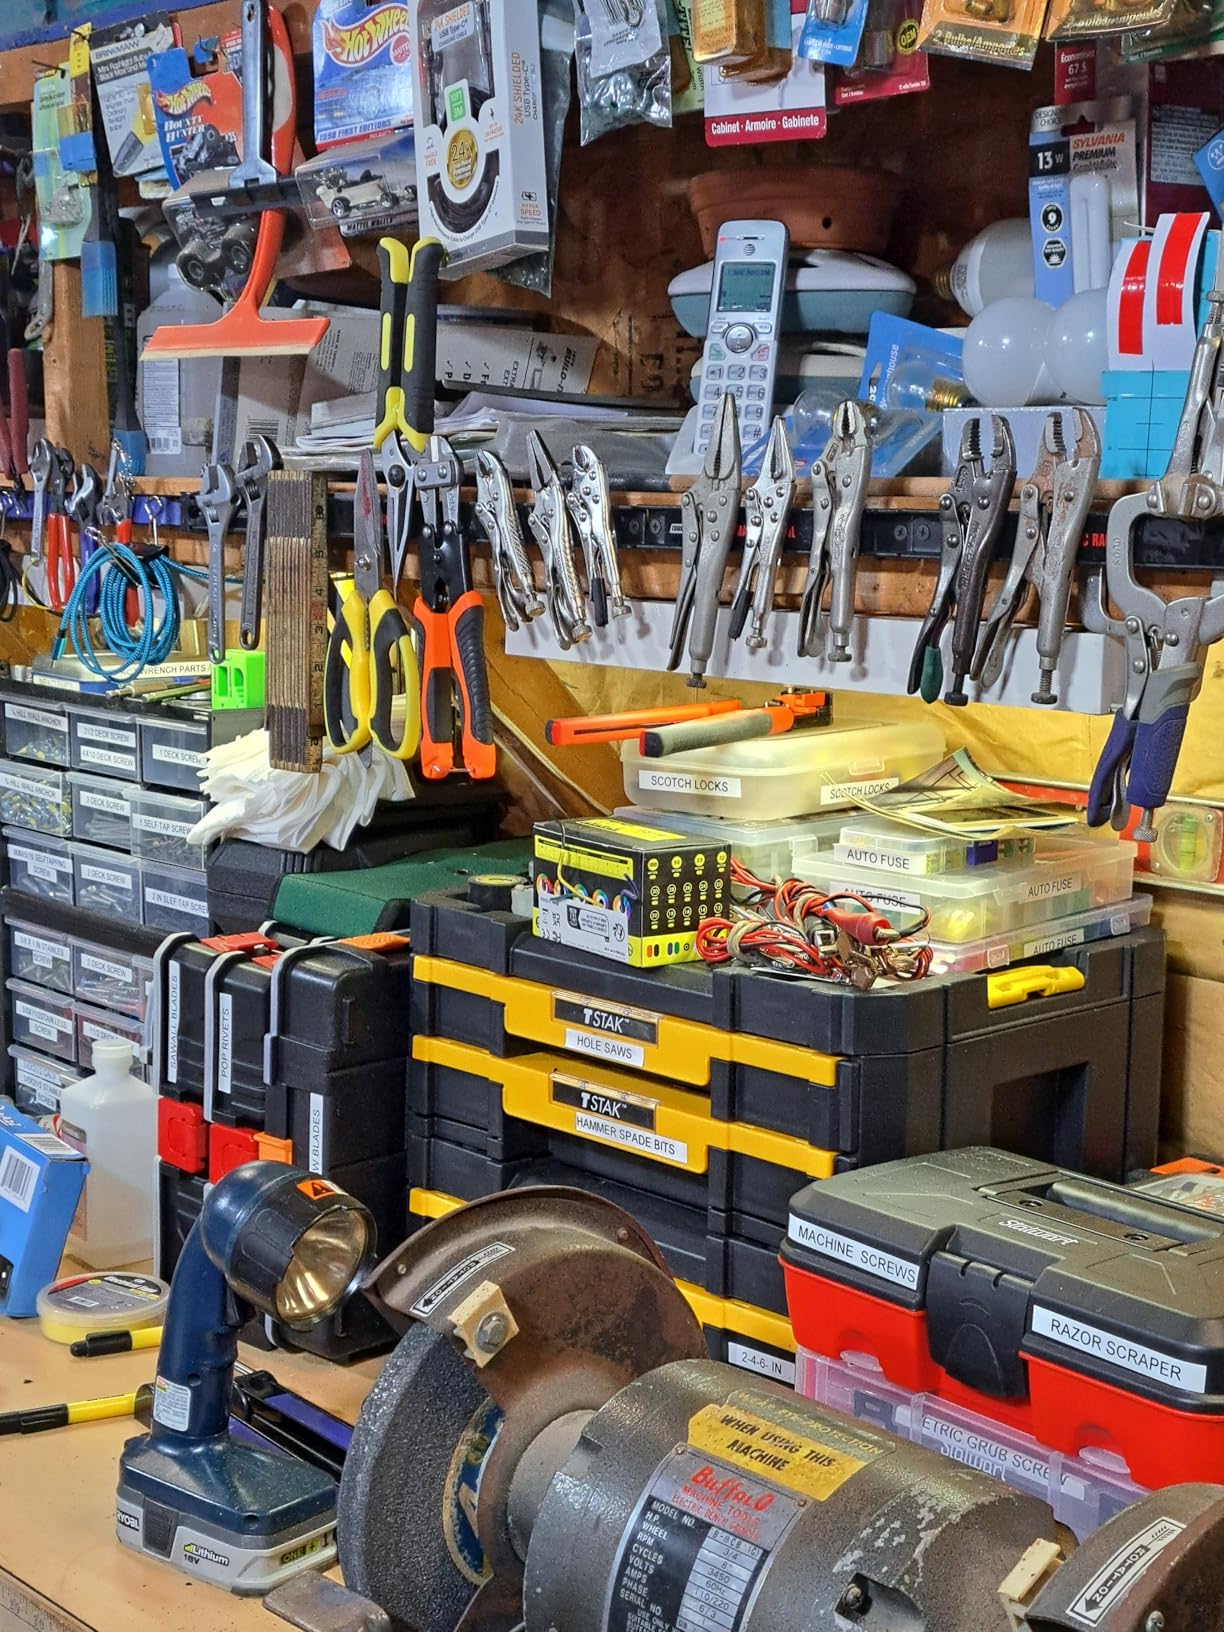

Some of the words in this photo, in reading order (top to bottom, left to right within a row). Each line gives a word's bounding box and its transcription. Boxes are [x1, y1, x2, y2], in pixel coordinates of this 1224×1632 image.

[900, 26, 917, 47] OEM
[511, 52, 523, 104] SHIELDED
[523, 99, 532, 117] USB
[163, 115, 204, 131] BOUNTY
[165, 123, 206, 143] HUNTER
[711, 119, 740, 135] Cabinet
[745, 118, 777, 132] Armoire
[782, 113, 820, 129] Gabinete
[1072, 131, 1126, 149] SYLVANIA
[1072, 146, 1117, 161] PREMIUM
[520, 208, 541, 217] SPEED
[178, 664, 206, 674] PARTS
[113, 755, 134, 767] SCREW
[164, 750, 180, 760] DECK
[180, 752, 202, 765] SCREW
[650, 774, 692, 790] SCOTCH
[694, 778, 730, 793] LOCKS
[863, 781, 891, 796] LOCKS
[846, 848, 879, 866] AUTO
[880, 853, 911, 870] FUSE
[1027, 882, 1049, 898] AUTO
[1049, 878, 1073, 895] FUSE
[1033, 938, 1056, 955] AUTO
[1056, 934, 1078, 949] FUSE
[170, 975, 180, 1018] BLADES
[221, 1007, 230, 1051] RIVETS
[576, 1034, 602, 1049] HOLE
[604, 1041, 634, 1060] SAWS
[221, 1054, 230, 1078] POP
[311, 1108, 321, 1155] BLADES
[576, 1116, 617, 1137] HAMMER
[619, 1127, 652, 1148] SPADE
[653, 1138, 676, 1156] BITS
[797, 1224, 854, 1260] MACHINE
[860, 1248, 917, 1284] SCREWS
[1049, 1318, 1103, 1352] RAZOR
[1104, 1340, 1183, 1382] SCRAPER
[771, 1359, 784, 1376] IN
[720, 1413, 761, 1437] WHEN
[760, 1431, 804, 1455] USING
[803, 1449, 839, 1468] THIS
[922, 1416, 966, 1446] ETRIC
[967, 1433, 1009, 1464] GRUB
[726, 1438, 791, 1473] MACHINE
[650, 1500, 681, 1520] MODEL
[641, 1520, 669, 1541] WHEEL
[183, 1552, 200, 1566] 18V
[192, 1544, 230, 1567] Lithium
[636, 1531, 655, 1547] RPM
[707, 1567, 731, 1584] 3450
[723, 1546, 740, 1561] 3/4
[624, 1565, 648, 1585] AMPS
[632, 1543, 665, 1566] CYCLES
[705, 1579, 727, 1597] 60Hz
[1092, 1544, 1146, 1603] ROTATION
[629, 1554, 656, 1575] VOLTS
[694, 1587, 730, 1612] 110/220
[619, 1588, 646, 1610] SERIAL
